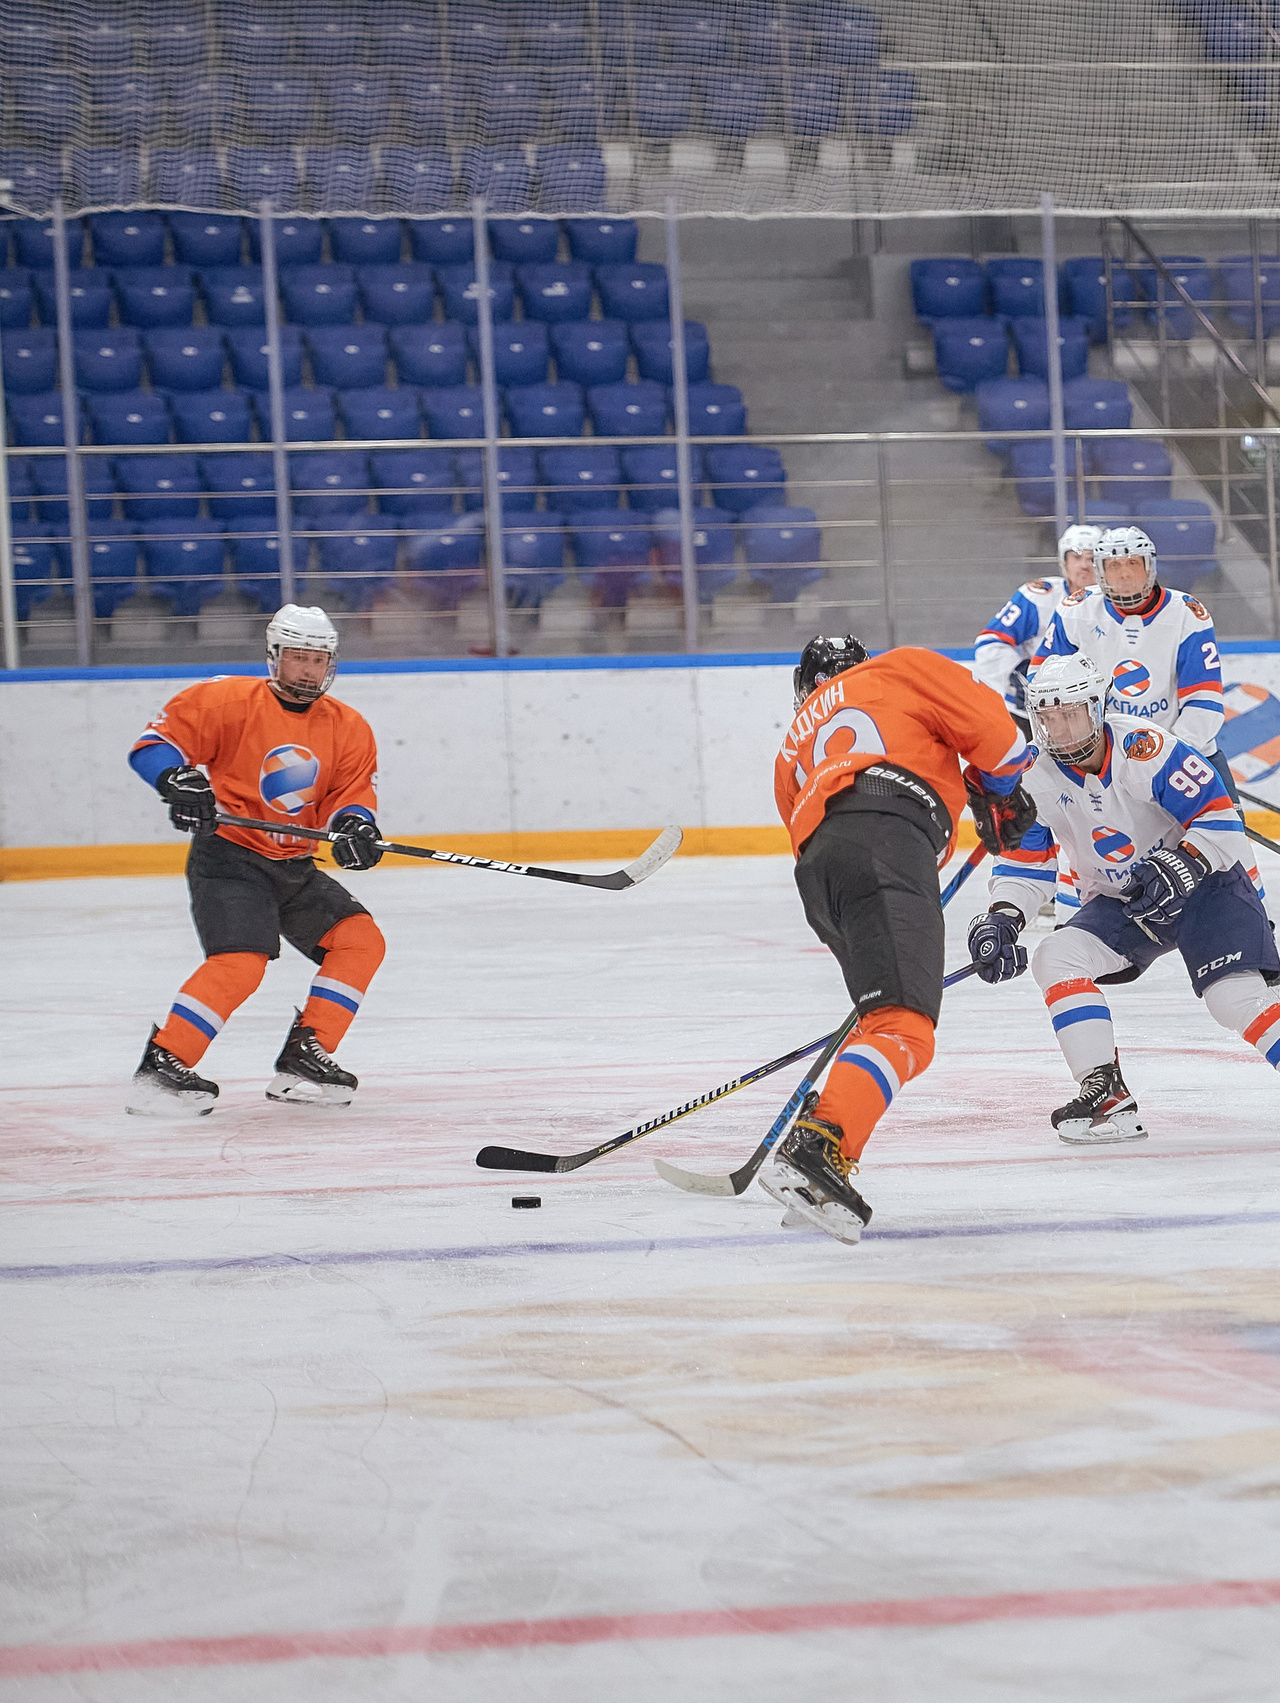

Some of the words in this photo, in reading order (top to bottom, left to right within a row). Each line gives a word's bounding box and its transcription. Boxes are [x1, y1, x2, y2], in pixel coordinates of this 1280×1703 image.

[864, 766, 937, 808] BAUER
[1168, 754, 1214, 798] 99
[1197, 950, 1243, 979] CCM
[763, 1078, 813, 1150] NEXUS
[1093, 1091, 1107, 1108] CCM
